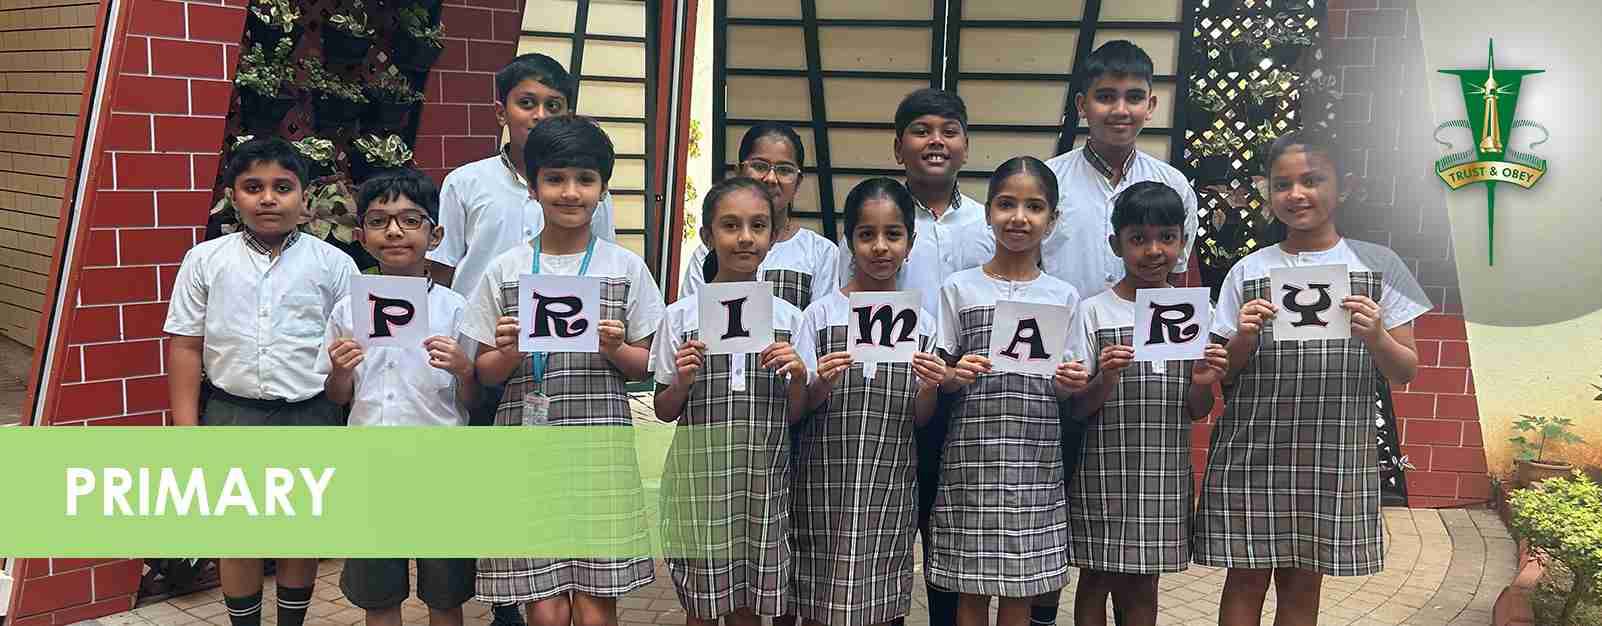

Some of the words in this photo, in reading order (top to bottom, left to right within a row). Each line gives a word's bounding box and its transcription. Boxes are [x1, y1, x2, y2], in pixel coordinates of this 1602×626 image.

[368, 293, 416, 339] P
[528, 291, 589, 339] R
[720, 296, 750, 341] I
[1143, 300, 1200, 346] R
[1282, 283, 1332, 328] Y
[999, 317, 1051, 360] A
